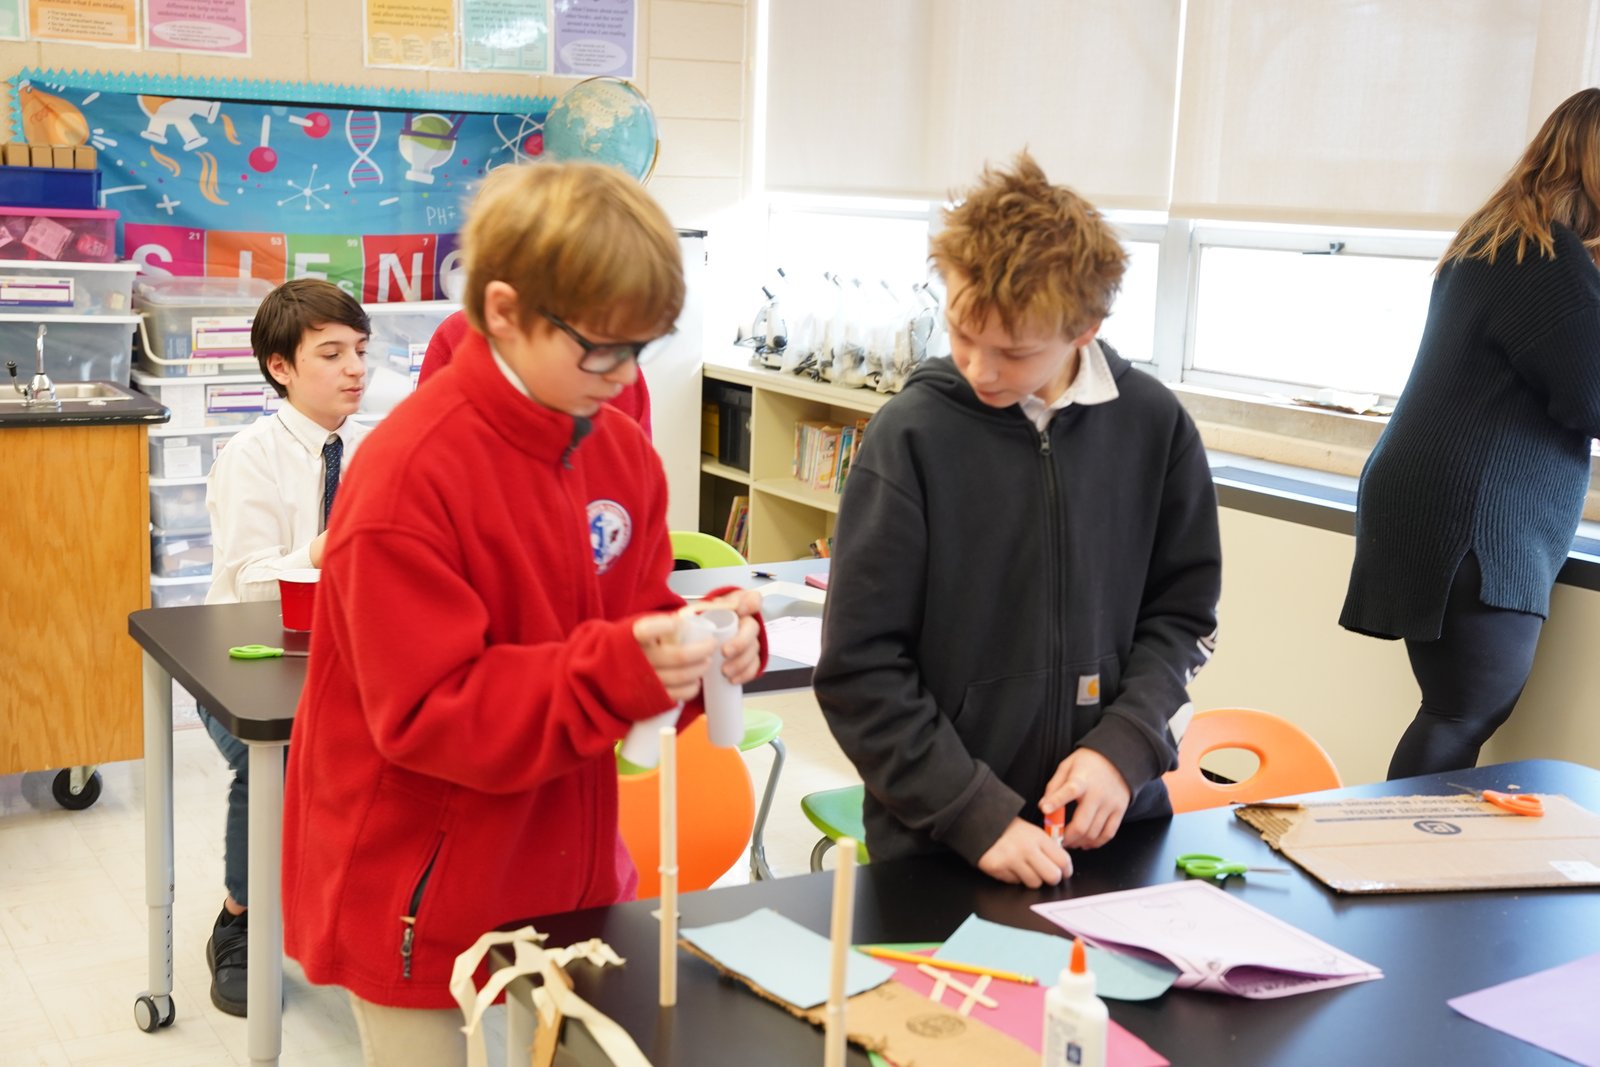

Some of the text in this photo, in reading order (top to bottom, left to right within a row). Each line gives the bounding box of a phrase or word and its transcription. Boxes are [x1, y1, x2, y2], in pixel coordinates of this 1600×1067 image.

[188, 232, 200, 240] 21
[347, 239, 358, 248] 99
[423, 238, 428, 246] 7
[377, 252, 424, 303] N
